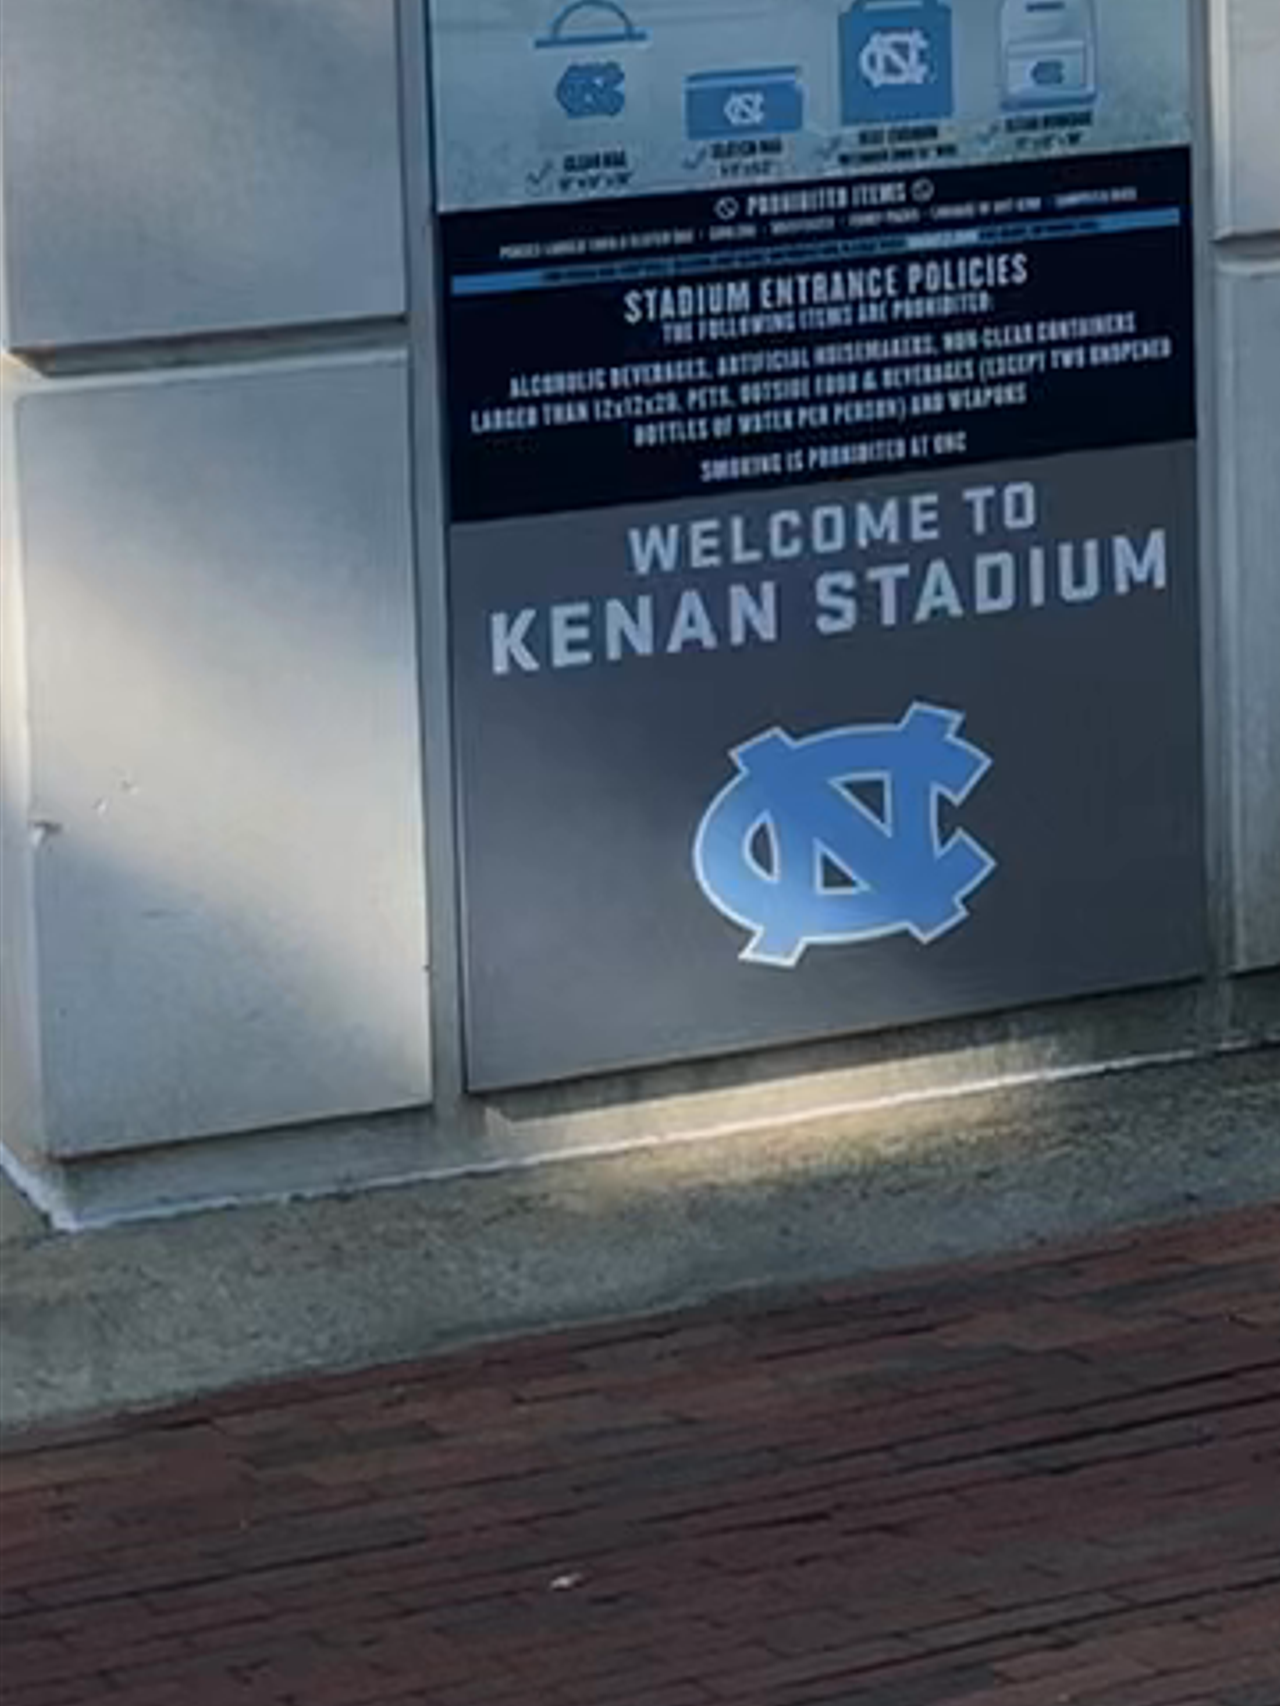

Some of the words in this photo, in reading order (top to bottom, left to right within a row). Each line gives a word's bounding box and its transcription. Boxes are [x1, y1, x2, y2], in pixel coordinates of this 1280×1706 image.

[624, 280, 752, 324] STADIUM
[760, 263, 900, 310] ENTRANCE
[908, 252, 1029, 295] POLICIES
[627, 493, 940, 576] WELCOME
[964, 481, 1037, 535] TO
[490, 581, 778, 676] KENAN
[814, 528, 1169, 636] STADIUM
